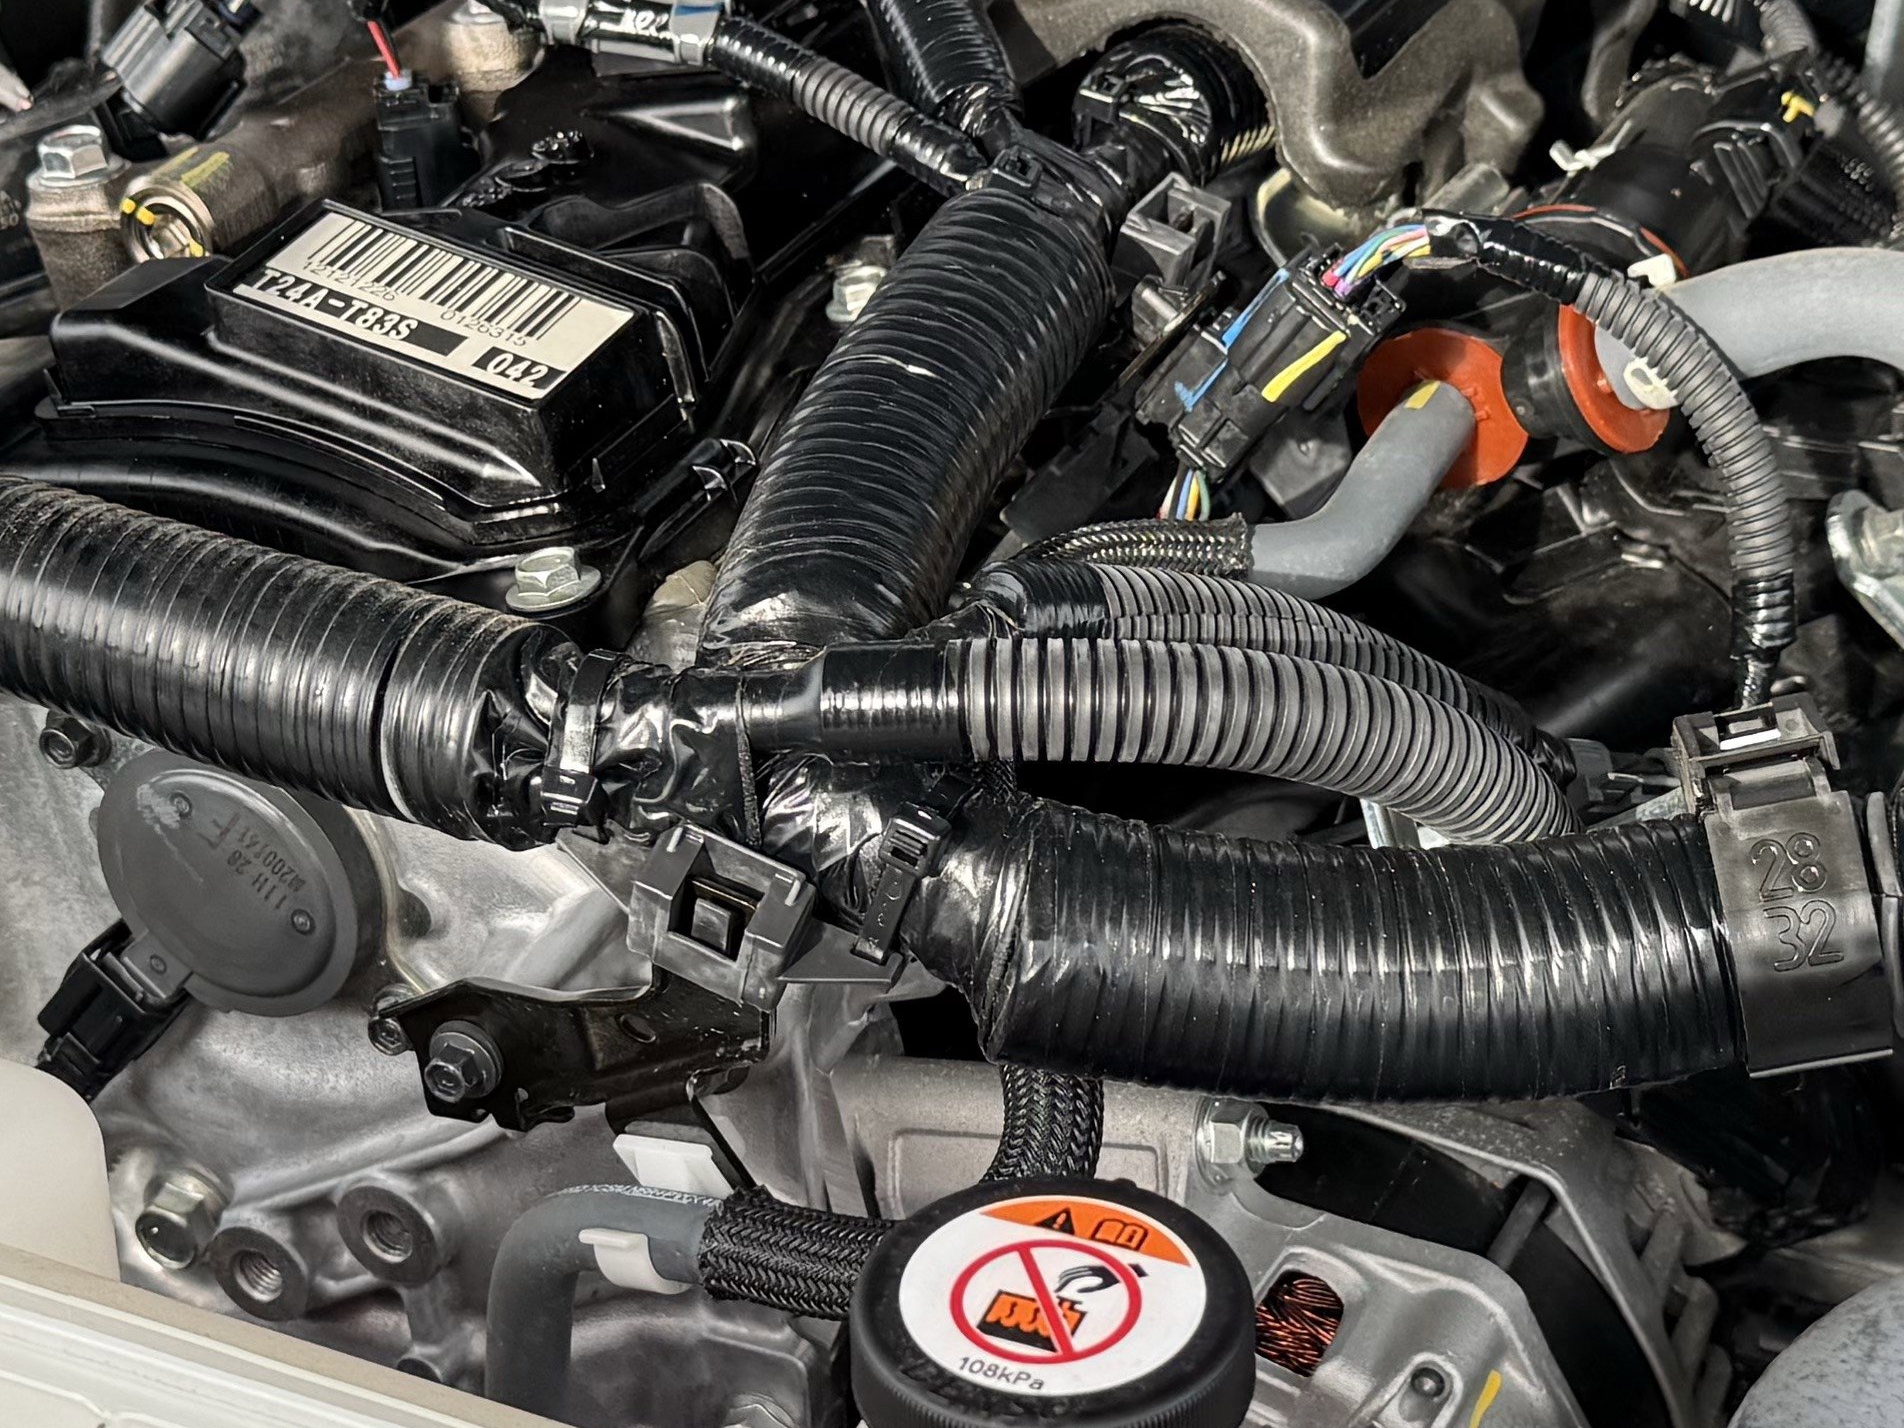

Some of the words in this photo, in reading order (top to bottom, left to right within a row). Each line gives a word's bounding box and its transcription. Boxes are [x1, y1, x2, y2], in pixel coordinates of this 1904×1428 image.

[253, 271, 418, 342] T24A-T83S
[485, 351, 549, 386] 042
[1749, 831, 1828, 903] 28
[1763, 898, 1845, 972] 32
[957, 1355, 1046, 1392] 108kPa
